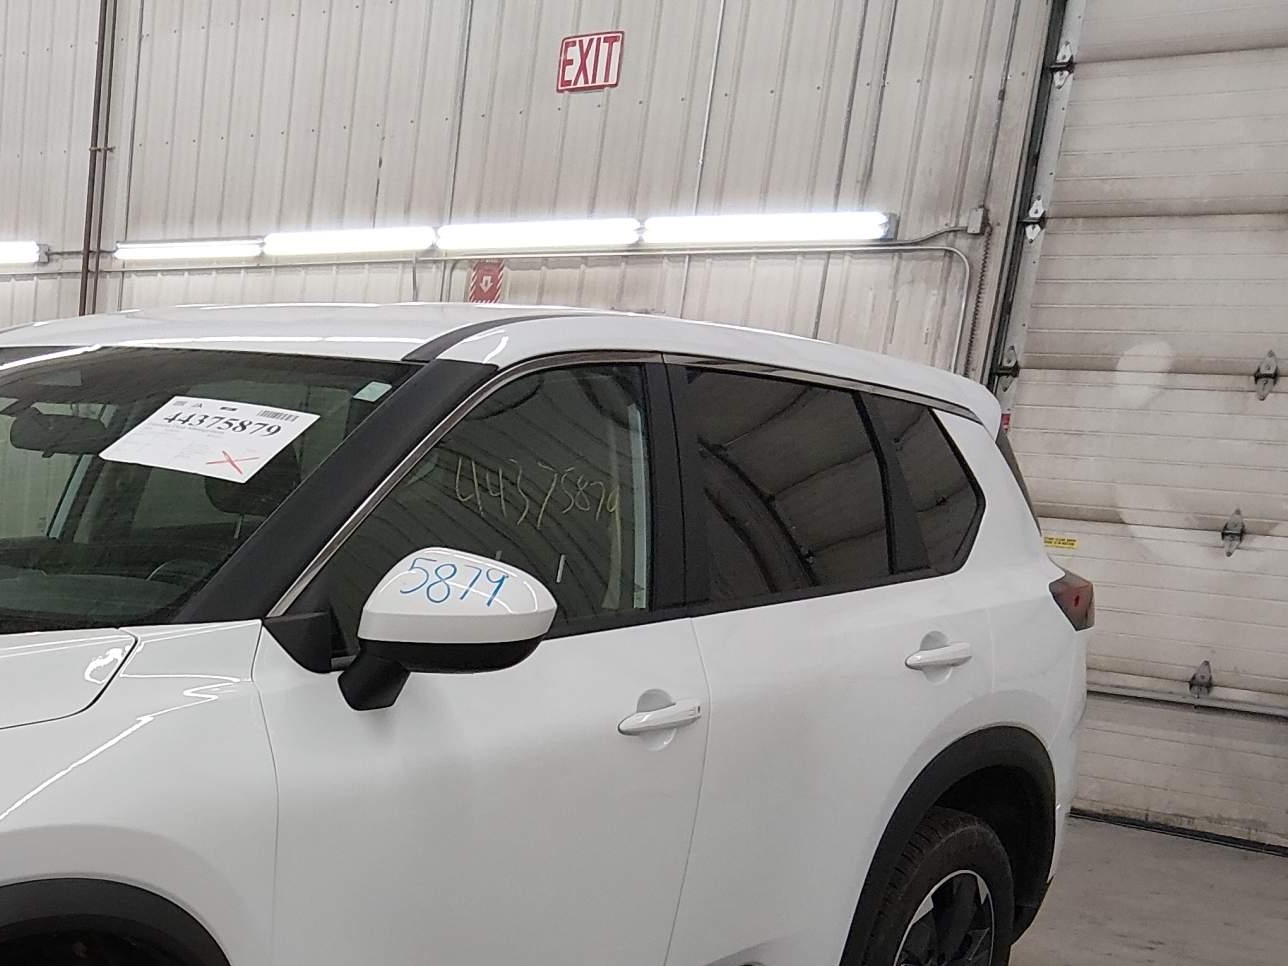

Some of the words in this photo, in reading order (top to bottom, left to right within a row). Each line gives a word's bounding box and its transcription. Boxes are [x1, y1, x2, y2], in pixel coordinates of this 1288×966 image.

[560, 36, 621, 87] EXIT
[164, 411, 282, 437] 44375879
[400, 557, 509, 607] 5879
